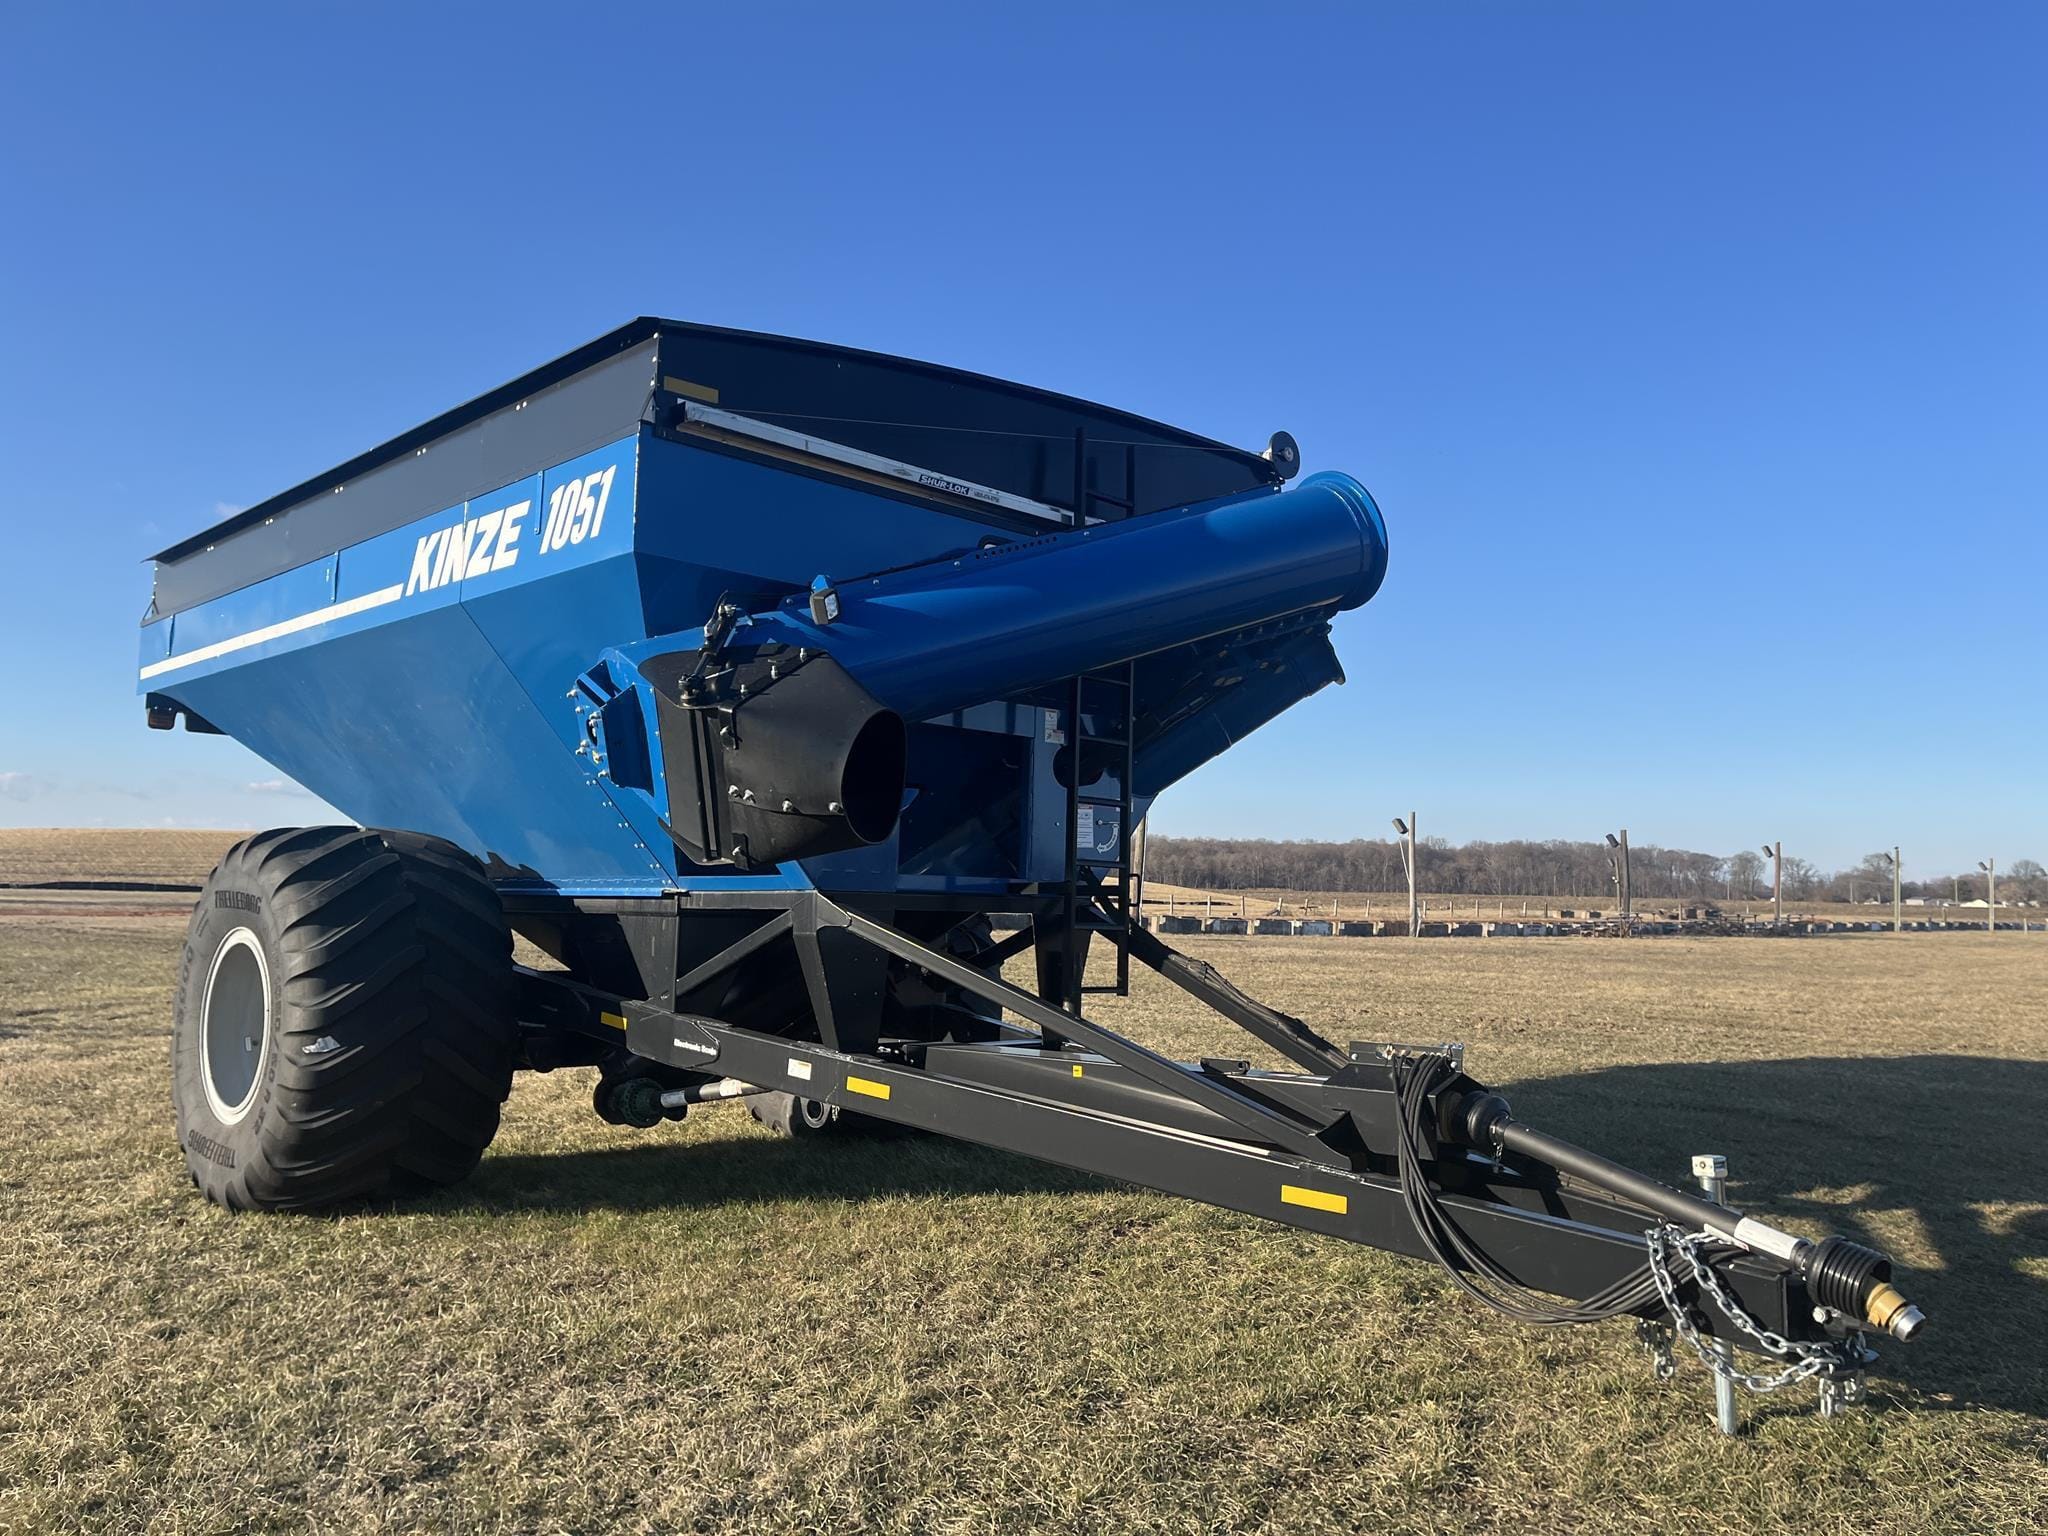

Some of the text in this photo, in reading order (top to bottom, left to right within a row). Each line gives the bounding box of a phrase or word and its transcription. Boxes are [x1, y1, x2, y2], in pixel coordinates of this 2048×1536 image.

[405, 464, 617, 597] KINZE 1051
[214, 890, 262, 915] TRELLEBORG
[187, 1129, 236, 1169] TRELLEBORG
